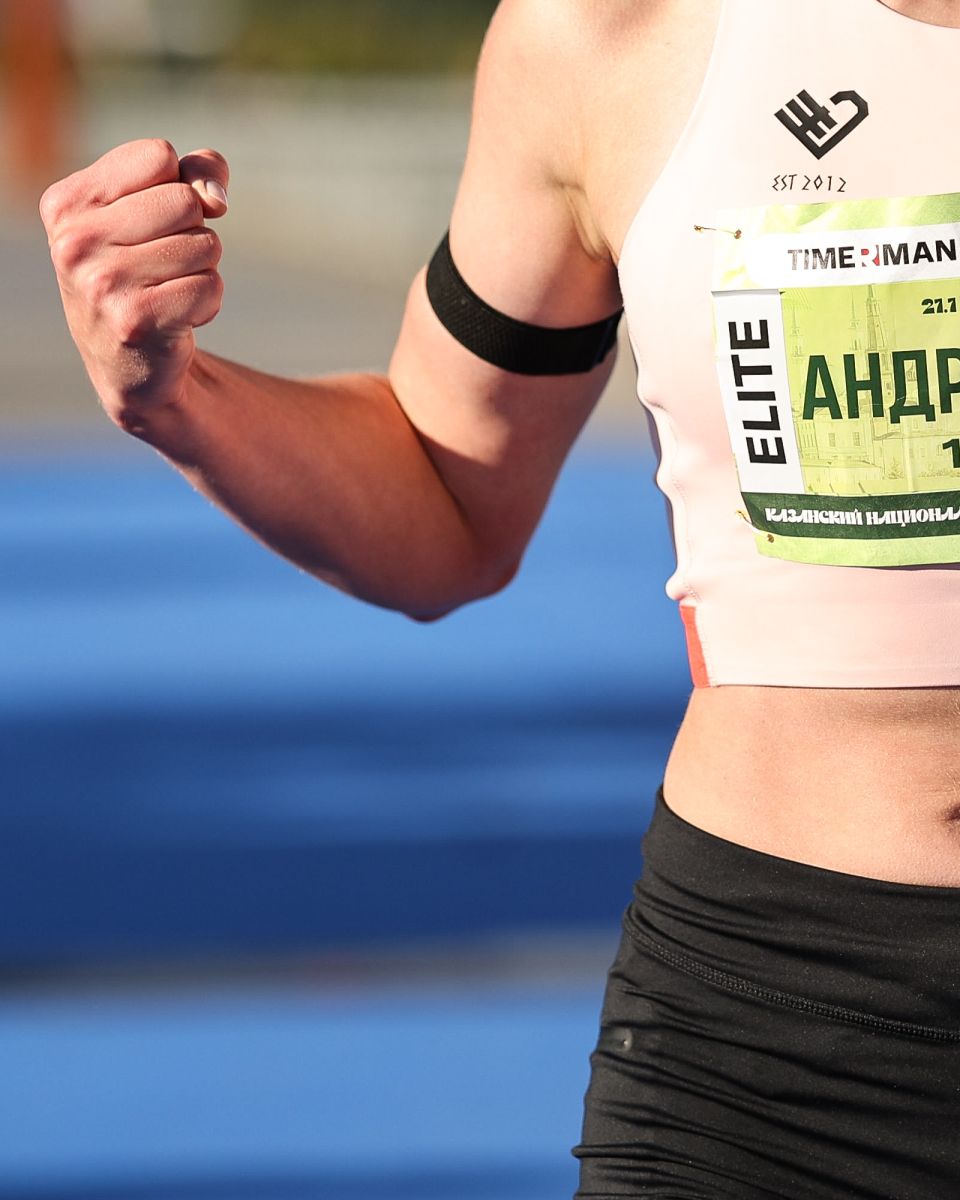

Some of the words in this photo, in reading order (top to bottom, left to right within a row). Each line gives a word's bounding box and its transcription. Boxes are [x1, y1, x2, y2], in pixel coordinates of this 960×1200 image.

[772, 173, 798, 191] EST
[801, 174, 847, 193] 2012
[921, 297, 957, 315] 21.1
[728, 319, 787, 464] ELITE
[764, 507, 863, 526] КАЗАНСКИЙ
